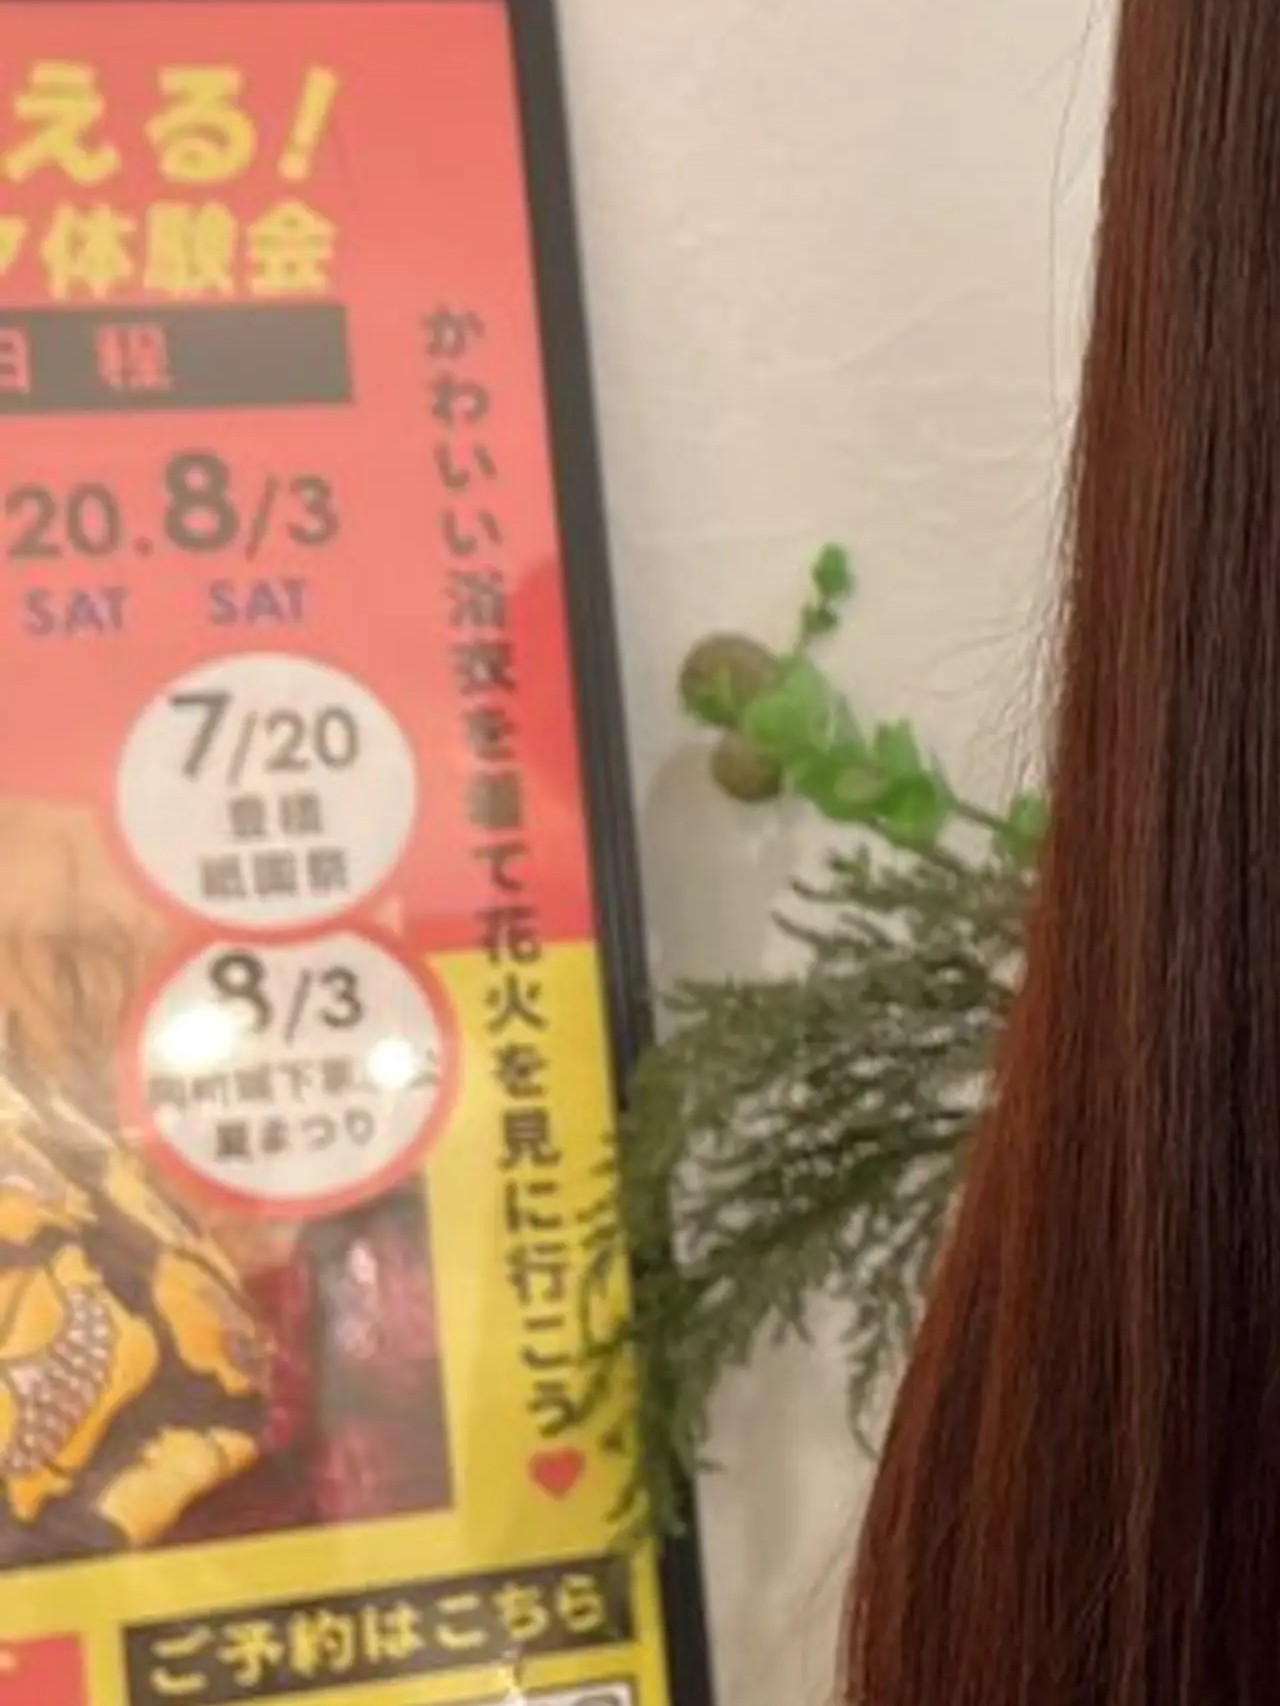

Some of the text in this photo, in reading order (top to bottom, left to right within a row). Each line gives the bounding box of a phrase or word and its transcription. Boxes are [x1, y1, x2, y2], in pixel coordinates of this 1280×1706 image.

[22, 577, 308, 636] SAT SAT
[170, 690, 360, 786] 7/20
[209, 950, 365, 1046] 8/3
[150, 1572, 605, 1694] ご予約はこちら
